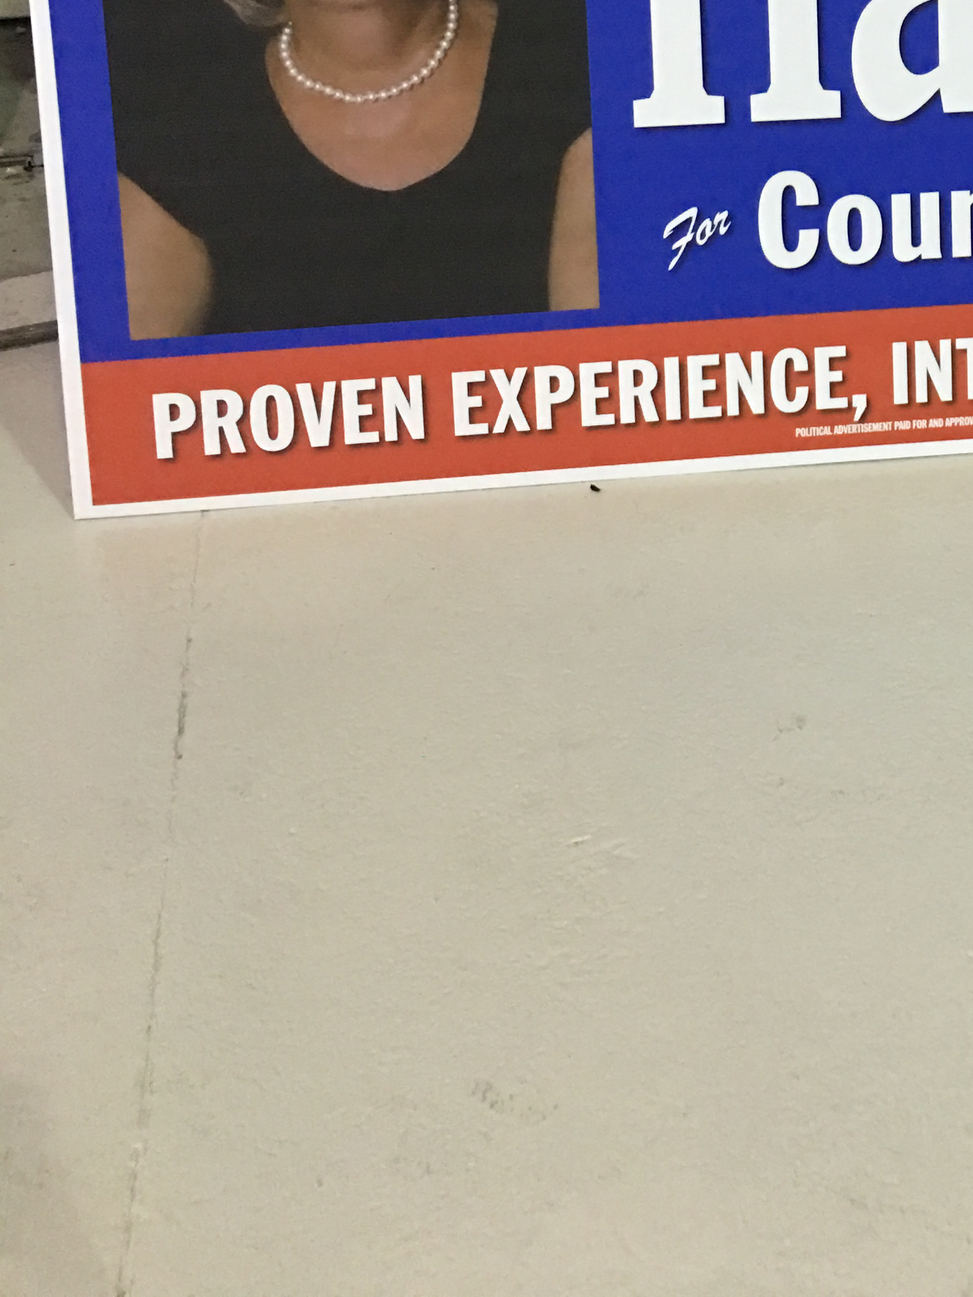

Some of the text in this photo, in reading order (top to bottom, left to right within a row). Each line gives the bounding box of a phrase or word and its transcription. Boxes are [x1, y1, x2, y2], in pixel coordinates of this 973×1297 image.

[662, 206, 731, 271] For
[152, 374, 425, 460] PROVEN
[451, 345, 867, 438] EXPERIENCE,
[795, 426, 832, 438] POLITICAL
[833, 421, 892, 435] ADVERTISEMENT
[894, 420, 911, 431] PAID
[912, 419, 927, 430] FOR
[928, 418, 943, 428] AND
